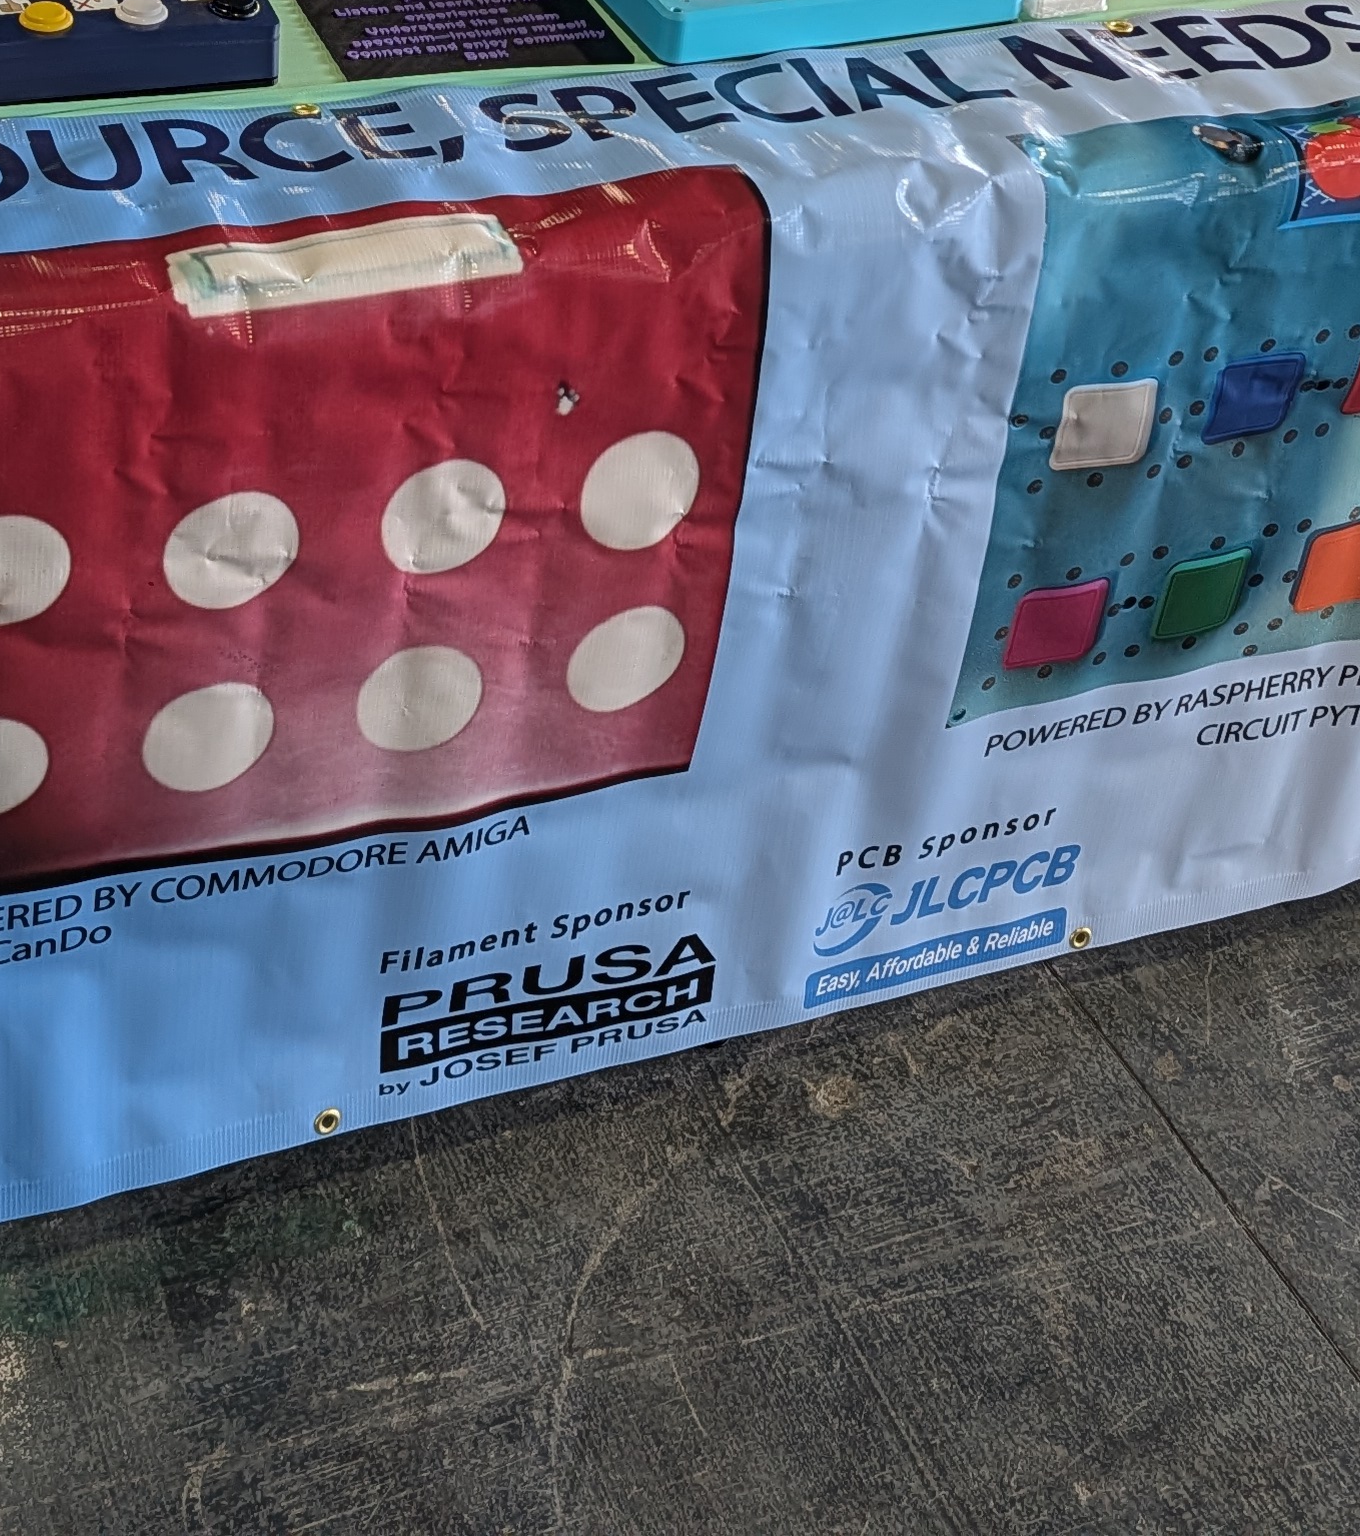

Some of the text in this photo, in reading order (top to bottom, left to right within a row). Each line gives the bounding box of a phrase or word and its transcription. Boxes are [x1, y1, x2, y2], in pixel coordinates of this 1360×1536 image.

[333, 7, 390, 17] Listen
[394, 1, 426, 12] and
[346, 29, 606, 60] Connect and enjoy community
[364, 12, 560, 36] Understand the autism
[404, 7, 508, 22] experiences
[530, 19, 587, 33] myself
[497, 46, 1016, 154] SPECIAL
[983, 705, 1128, 759] POWERED
[1131, 692, 1175, 723] BY
[1172, 666, 1336, 718] RASPHERRY
[1195, 706, 1306, 749] CIRCUIT
[93, 881, 142, 913] BY
[150, 841, 408, 904] COMMODORE
[415, 814, 531, 865] AMIGA
[836, 807, 1058, 877] PCB Sponsor
[890, 843, 1083, 927] JLCPCB
[380, 888, 691, 975] Filament Sponsor
[815, 917, 1055, 998] Easy, Affordable & Reliable
[380, 934, 718, 1027] PRUSA
[396, 976, 702, 1061] RESEARCH
[379, 1008, 708, 1098] by JOSEF PRUSA
